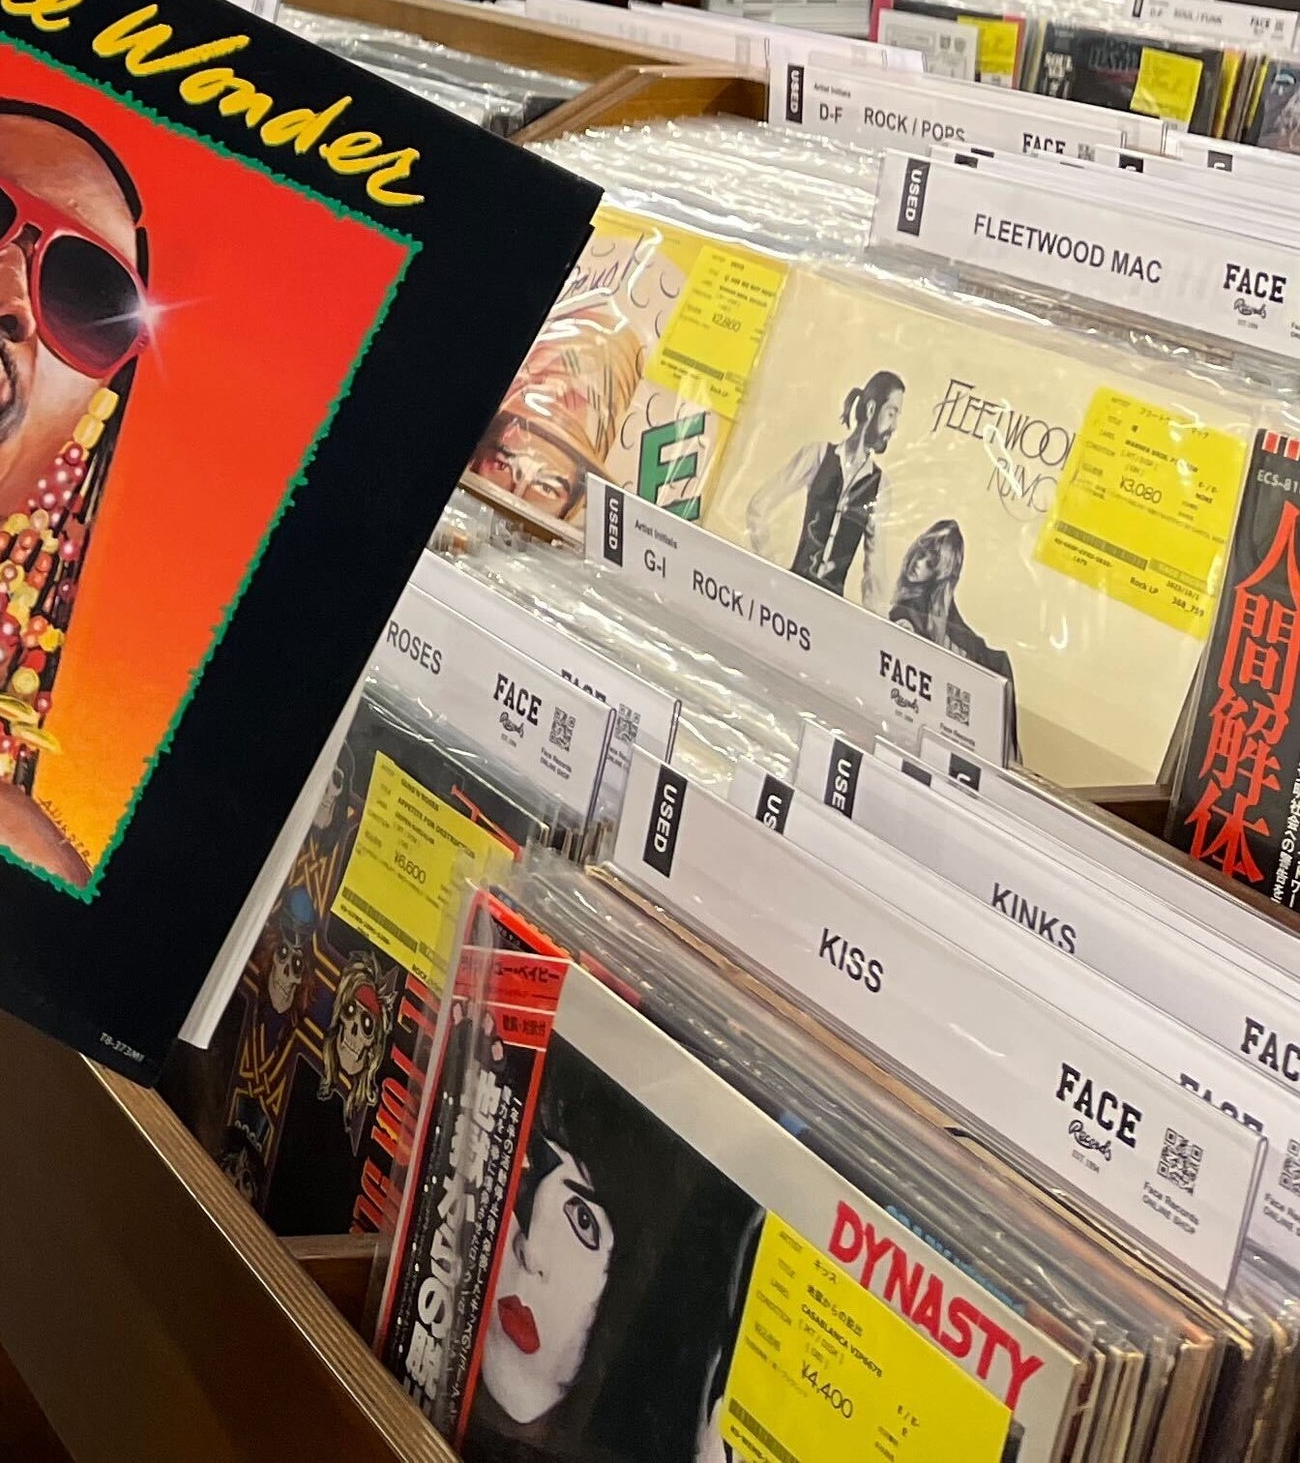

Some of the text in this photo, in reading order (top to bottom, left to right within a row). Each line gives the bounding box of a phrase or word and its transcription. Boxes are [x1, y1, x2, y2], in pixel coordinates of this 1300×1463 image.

[93, 4, 425, 206] Wonder
[789, 69, 801, 114] USED
[819, 103, 843, 122] D-F
[864, 107, 907, 136] ROCK
[921, 122, 965, 143] POPS
[903, 169, 924, 223] USED
[973, 213, 1163, 284] FLEETWOOD MAC
[1222, 263, 1287, 304] FACE
[931, 379, 1076, 472] FLEETWOO
[608, 497, 619, 551] USED
[644, 549, 667, 579] G-I
[693, 569, 744, 617] ROCK
[759, 604, 812, 652] POPS
[386, 620, 442, 675] ROSES
[493, 673, 543, 727] FACE
[879, 650, 933, 702] FACE
[1185, 500, 1300, 884] 人間解体
[831, 757, 853, 812] USE
[653, 783, 678, 854] USED
[762, 793, 784, 833] US
[991, 882, 1078, 954] KINKS
[818, 928, 884, 994] KISS
[1240, 1016, 1300, 1083] FAC
[1055, 1061, 1143, 1149] FACE
[1068, 1119, 1113, 1162] Records
[1142, 1194, 1197, 1235] ONLINE SHOP
[1143, 1181, 1200, 1226] Face Records
[800, 1303, 850, 1349] CASABLANCA
[827, 1200, 1049, 1412] DYNASTY
[801, 1359, 854, 1419] ¥4,400
